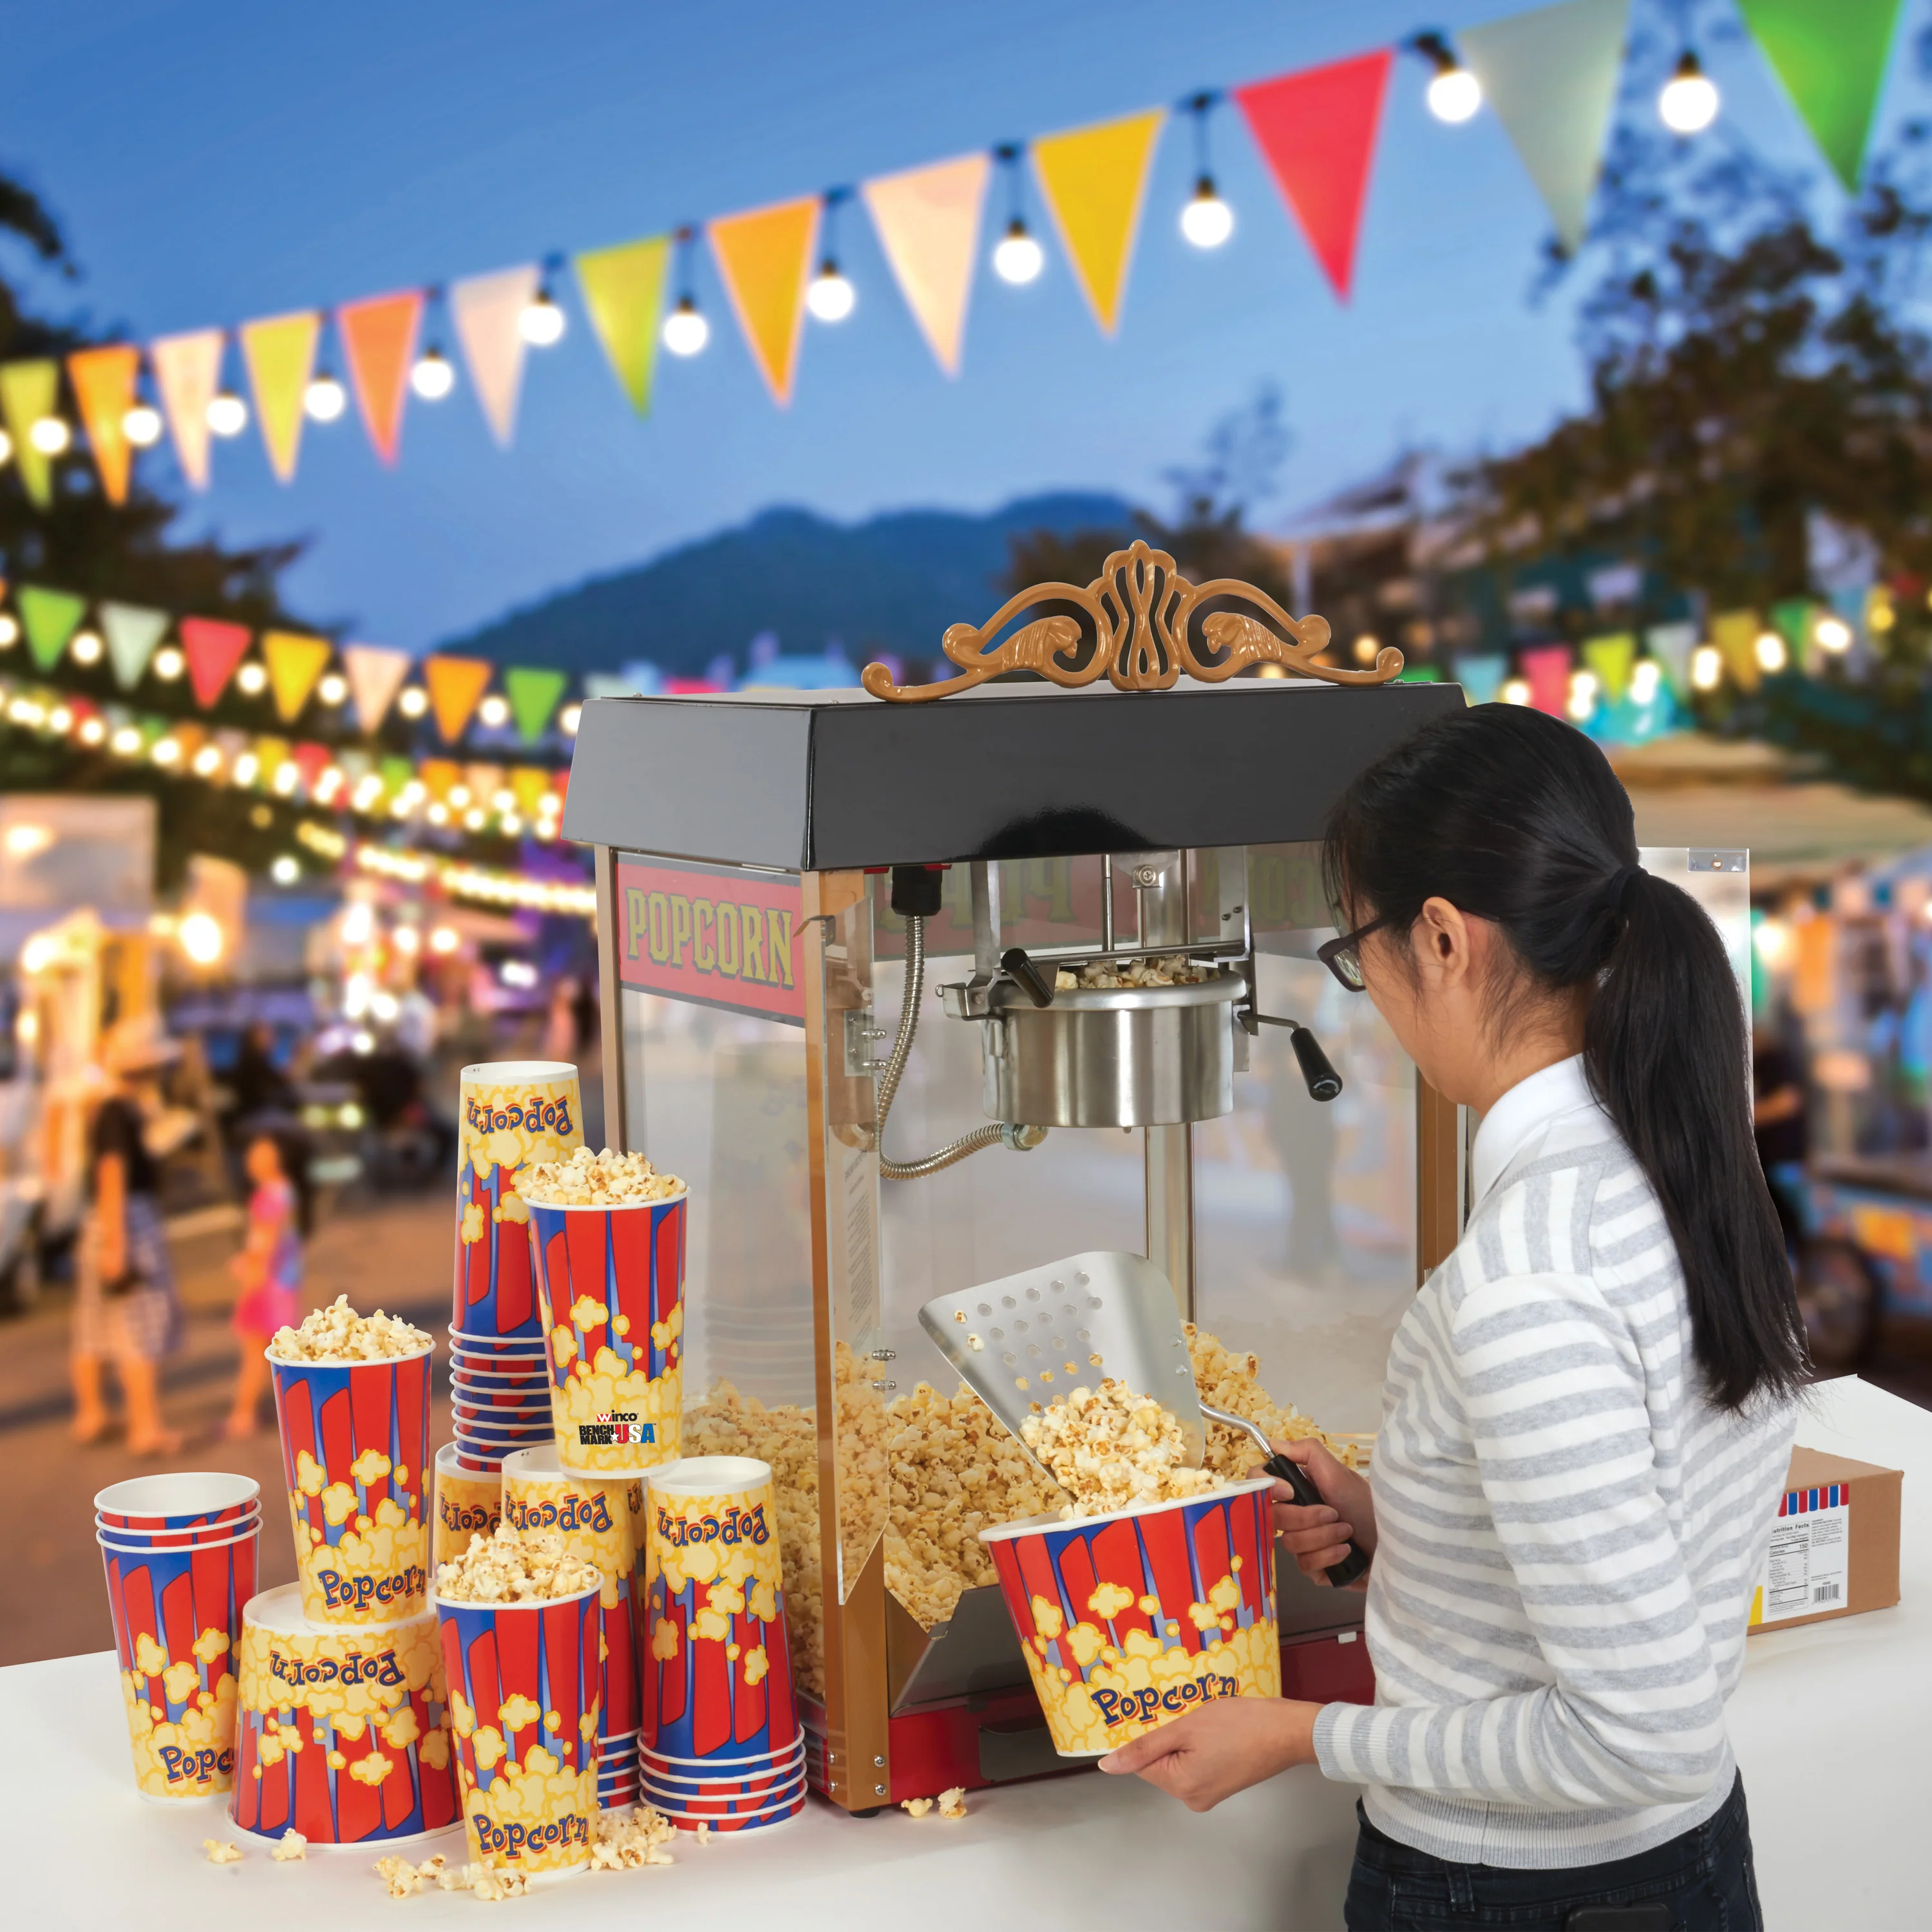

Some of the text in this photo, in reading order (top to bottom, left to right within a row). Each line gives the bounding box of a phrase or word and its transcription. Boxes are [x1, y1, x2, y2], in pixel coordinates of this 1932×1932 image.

[625, 887, 795, 990] POPCORN
[467, 1095, 574, 1135] Popcorn
[579, 1425, 614, 1435] BENCH
[580, 1435, 612, 1444] MARK
[505, 1490, 614, 1533] Popcorn
[658, 1502, 770, 1548] Popcorn
[1772, 1525, 1793, 1533] utrition
[317, 1565, 426, 1611] Popcorn
[270, 1649, 406, 1687] Popcorn
[1090, 1672, 1240, 1728] Popcorn
[158, 1745, 234, 1784] Popc
[473, 1814, 589, 1860] Popcorn
